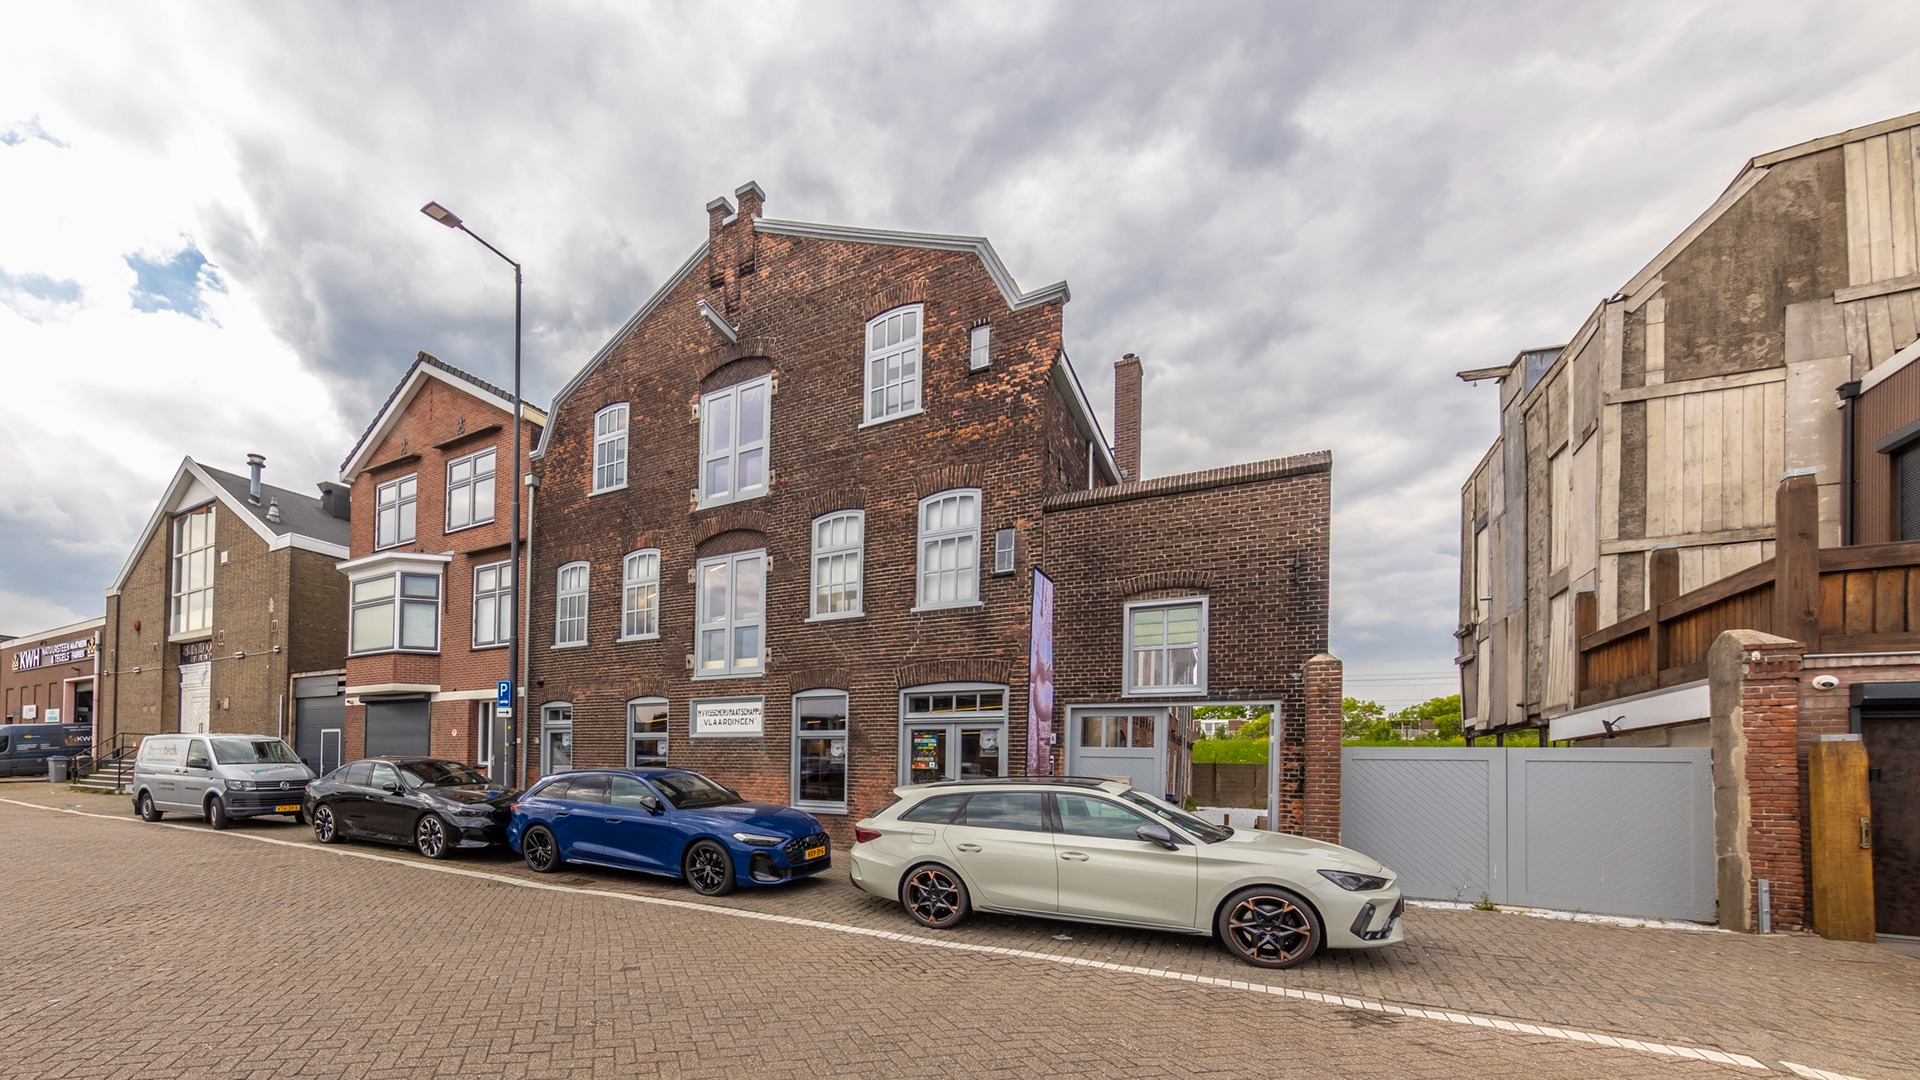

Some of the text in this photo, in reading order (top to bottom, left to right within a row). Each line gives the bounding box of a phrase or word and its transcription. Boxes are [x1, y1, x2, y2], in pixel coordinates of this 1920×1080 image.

[41, 642, 70, 656] NATUURSTEEN
[19, 648, 40, 669] KWH
[54, 652, 70, 663] TEGELS
[500, 683, 508, 697] P
